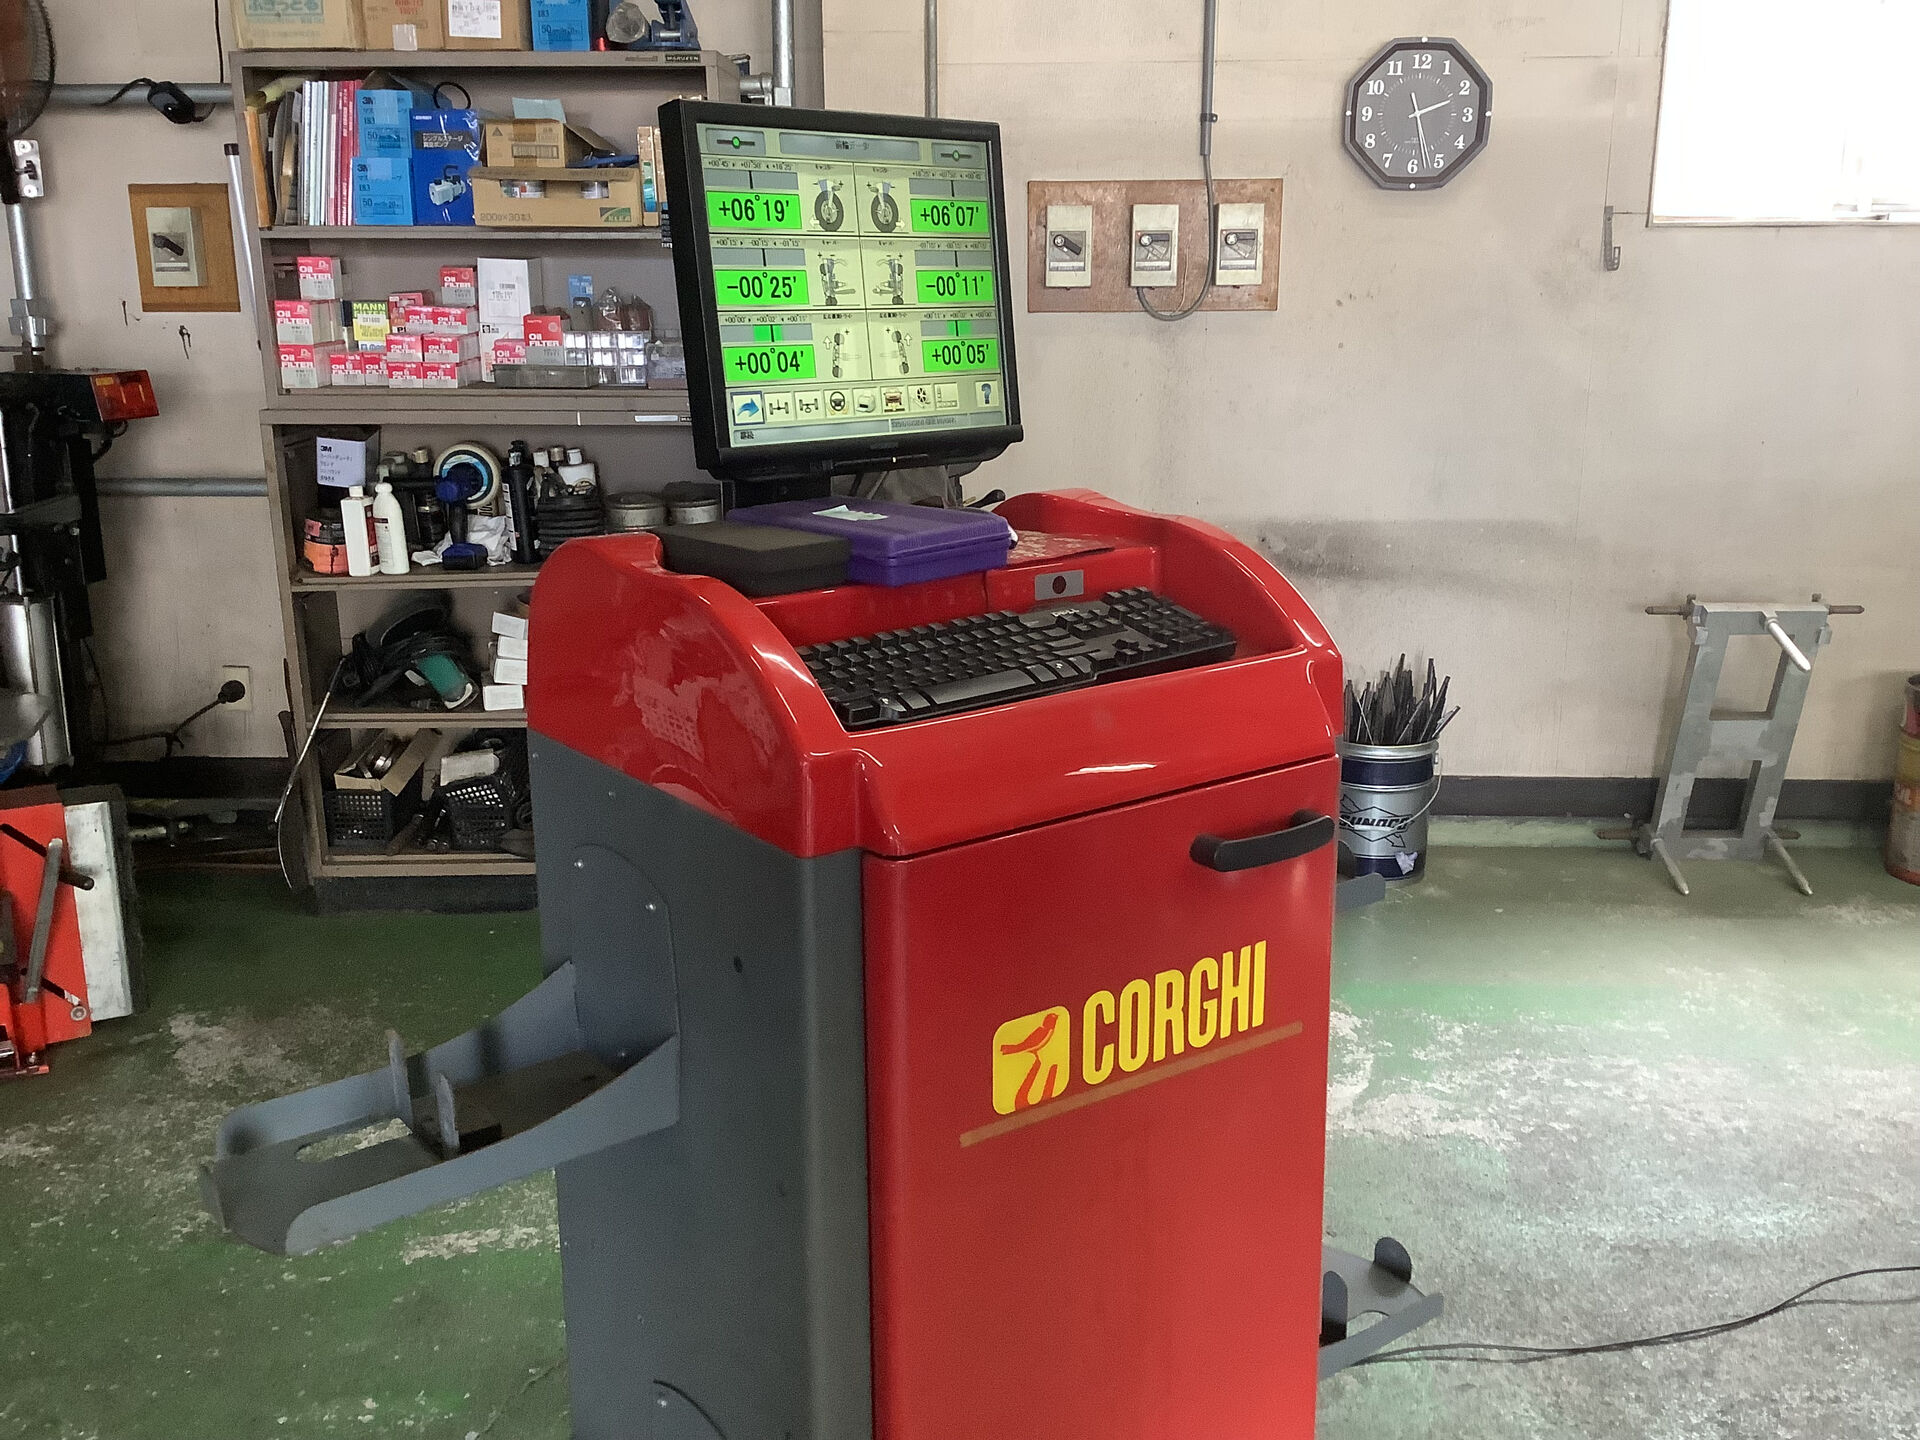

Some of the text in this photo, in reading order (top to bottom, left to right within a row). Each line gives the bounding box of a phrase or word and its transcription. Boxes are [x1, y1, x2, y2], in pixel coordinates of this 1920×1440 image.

[1386, 60, 1403, 76] 11
[1412, 53, 1432, 69] 12
[1442, 60, 1451, 75] 1
[1366, 79, 1385, 95] 10
[1458, 80, 1471, 95] 2
[1361, 106, 1373, 122] 9
[1461, 107, 1473, 123] 3
[1364, 133, 1376, 149] 8
[1454, 134, 1465, 150] 4
[1382, 153, 1393, 168] 7
[1407, 159, 1418, 174] 6
[1433, 153, 1445, 169] 5
[718, 195, 790, 223] +06°19'
[920, 202, 979, 227] +06°07'
[727, 272, 797, 299] -00°25'
[926, 272, 984, 297] -00°11'
[353, 303, 386, 311] MANN
[528, 333, 542, 341] Oil
[735, 348, 804, 374] +00°04'
[932, 341, 989, 365] +00°05'
[1083, 940, 1267, 1085] CORGHI
